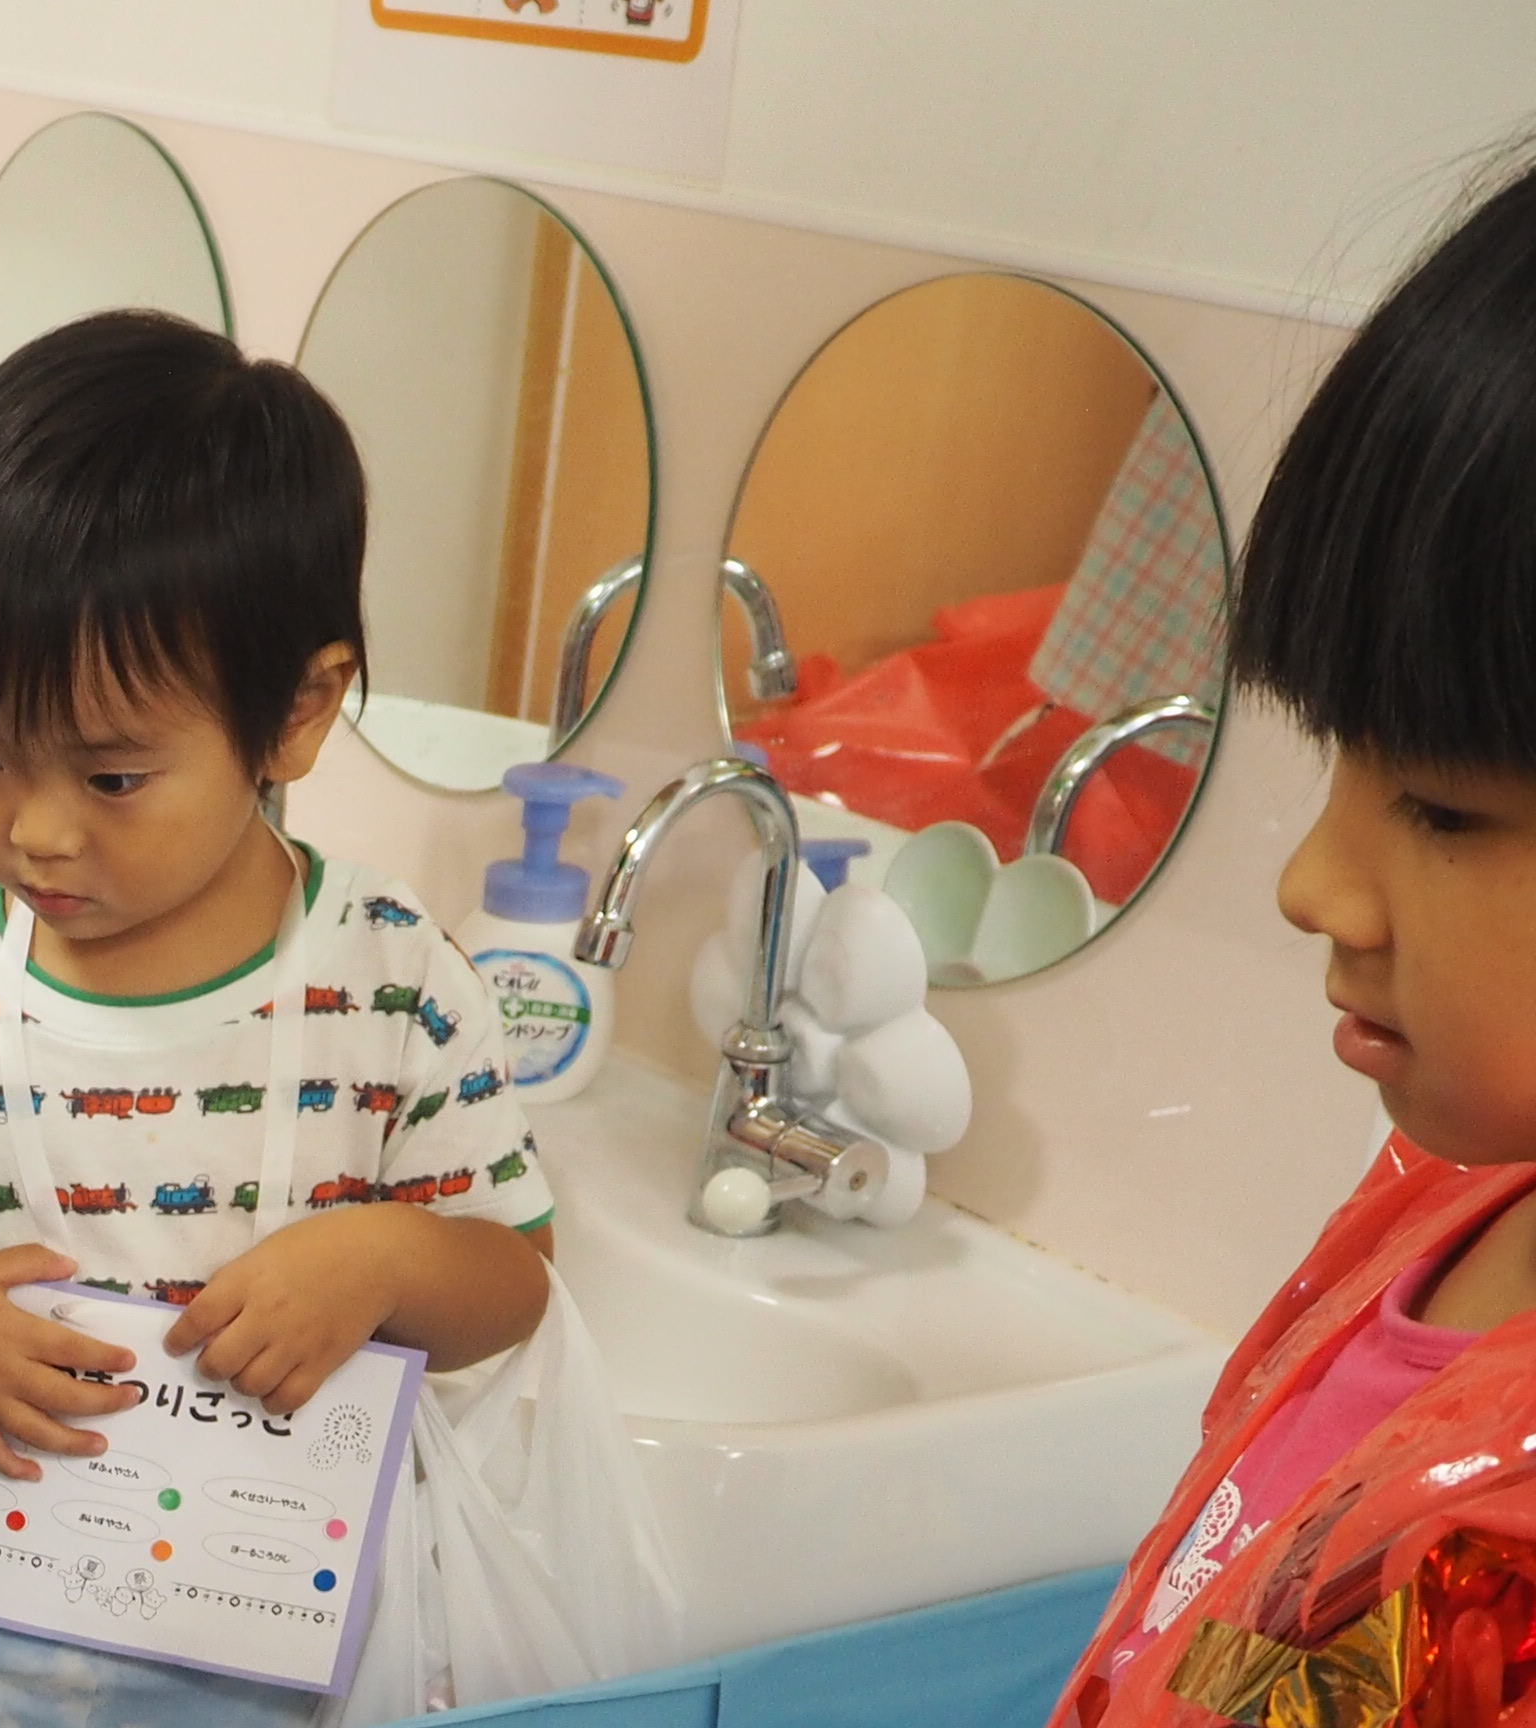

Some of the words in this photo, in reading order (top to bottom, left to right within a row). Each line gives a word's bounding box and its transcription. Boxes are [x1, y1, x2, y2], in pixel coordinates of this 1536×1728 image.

[504, 1023, 573, 1041] ンドソープ
[230, 1489, 307, 1511] あくせさりーやさん
[78, 1513, 131, 1532] あいすやさん
